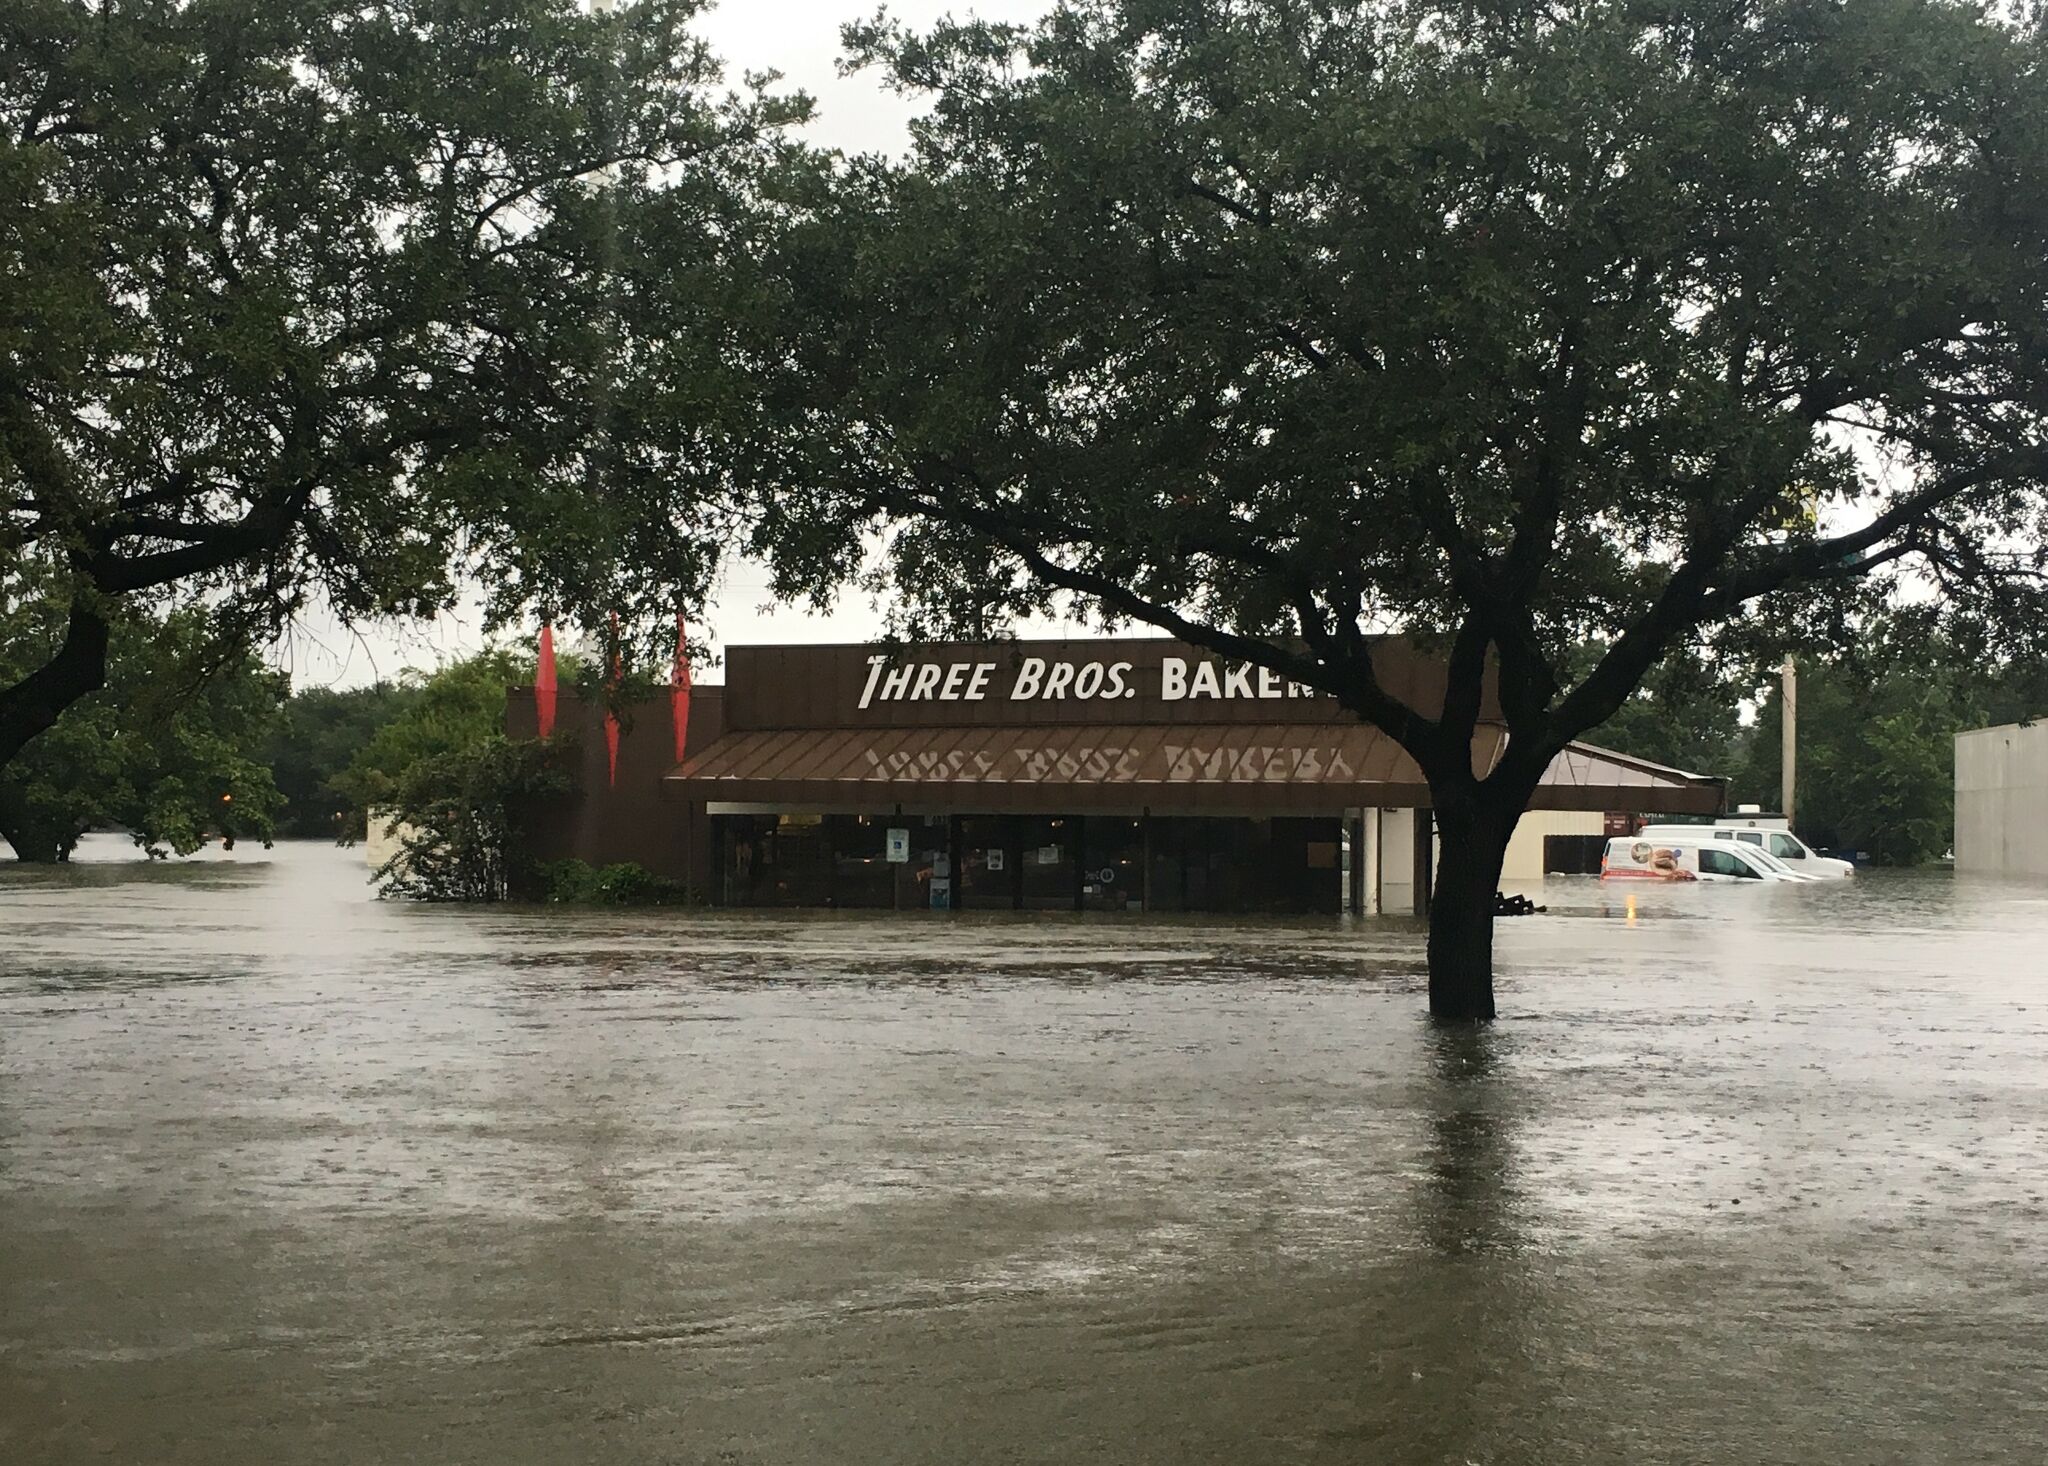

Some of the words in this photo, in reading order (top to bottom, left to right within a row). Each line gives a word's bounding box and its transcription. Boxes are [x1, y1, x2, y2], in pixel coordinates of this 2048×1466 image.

[857, 655, 997, 709] THREE
[1010, 657, 1136, 700] BROS.
[1161, 657, 1338, 700] BAKE
